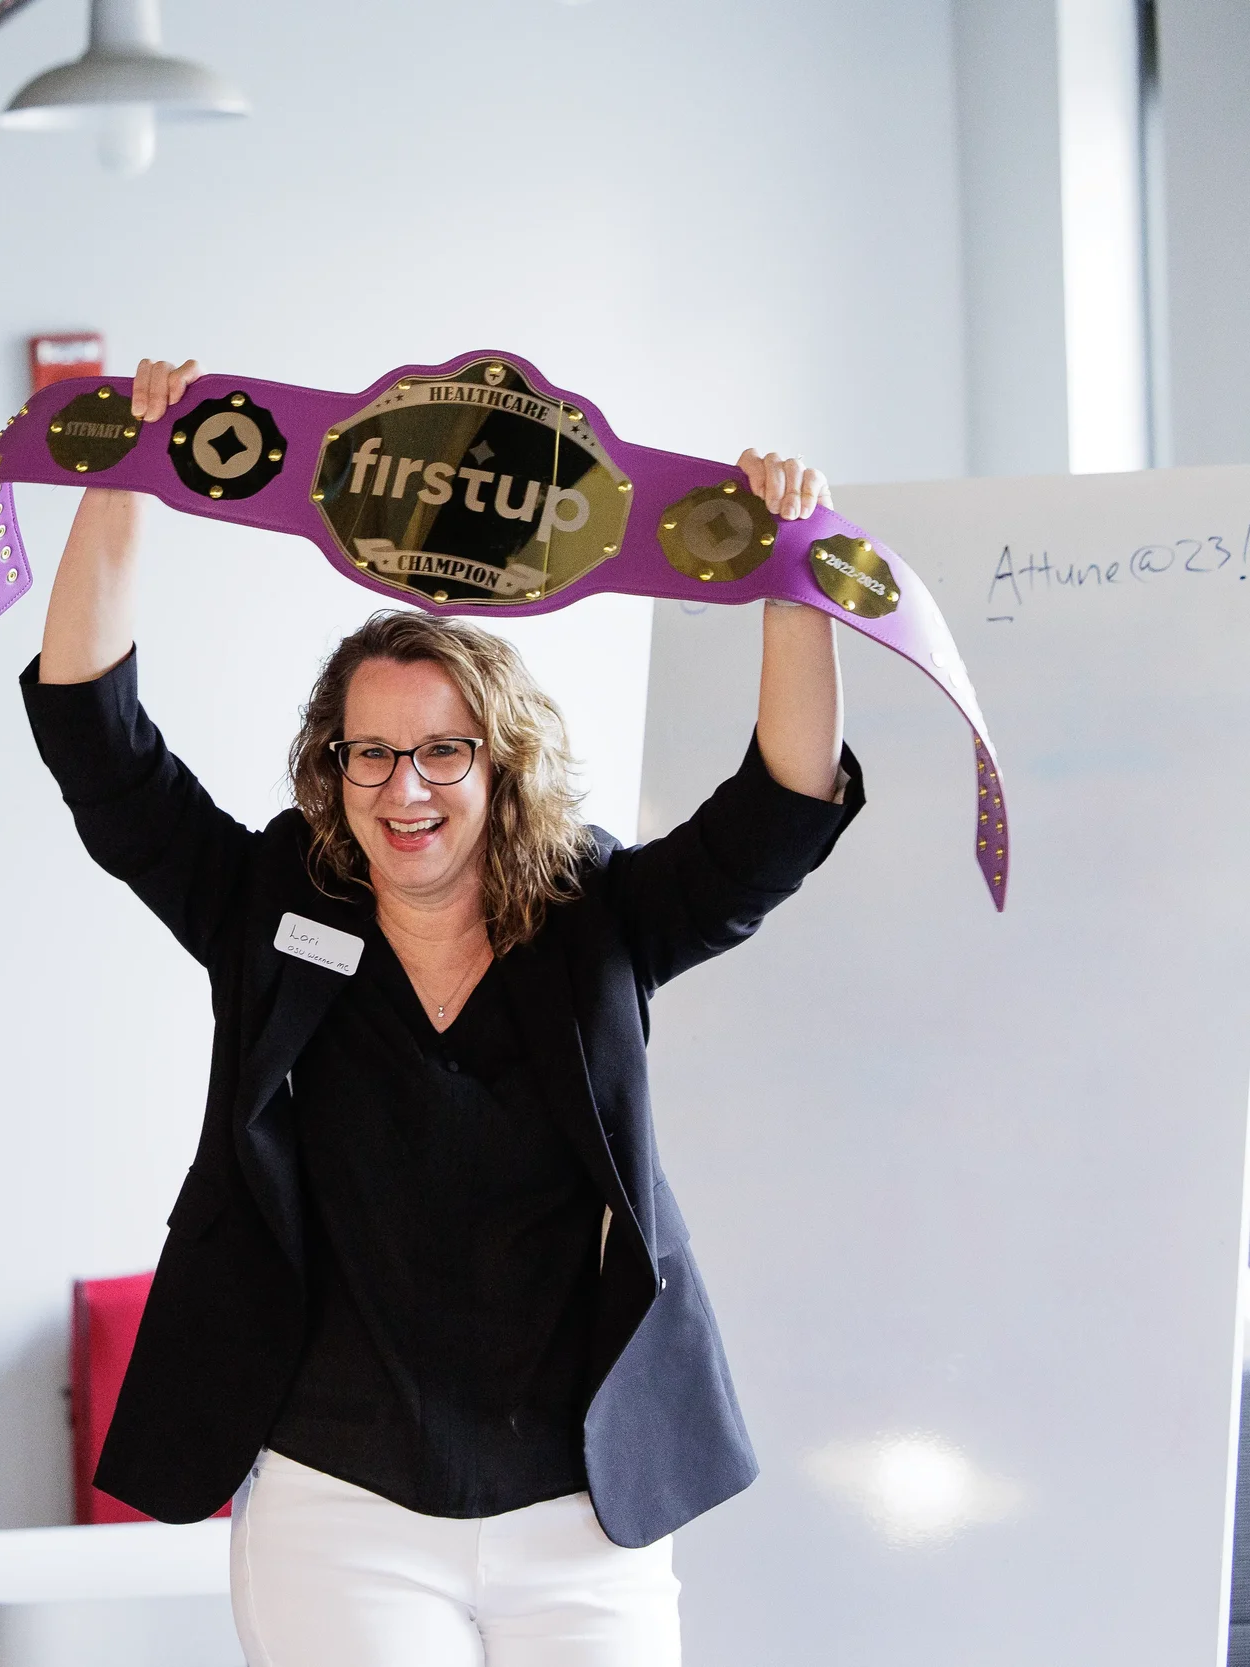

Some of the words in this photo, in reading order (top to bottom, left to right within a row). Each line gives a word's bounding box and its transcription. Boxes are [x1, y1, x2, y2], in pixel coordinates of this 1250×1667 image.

[429, 386, 550, 422] HEALTHCARE
[65, 421, 124, 439] STEWART
[350, 437, 590, 543] firstup
[397, 554, 502, 589] CHAMPION
[825, 553, 886, 596] 2022-2023
[290, 924, 319, 945] Lori
